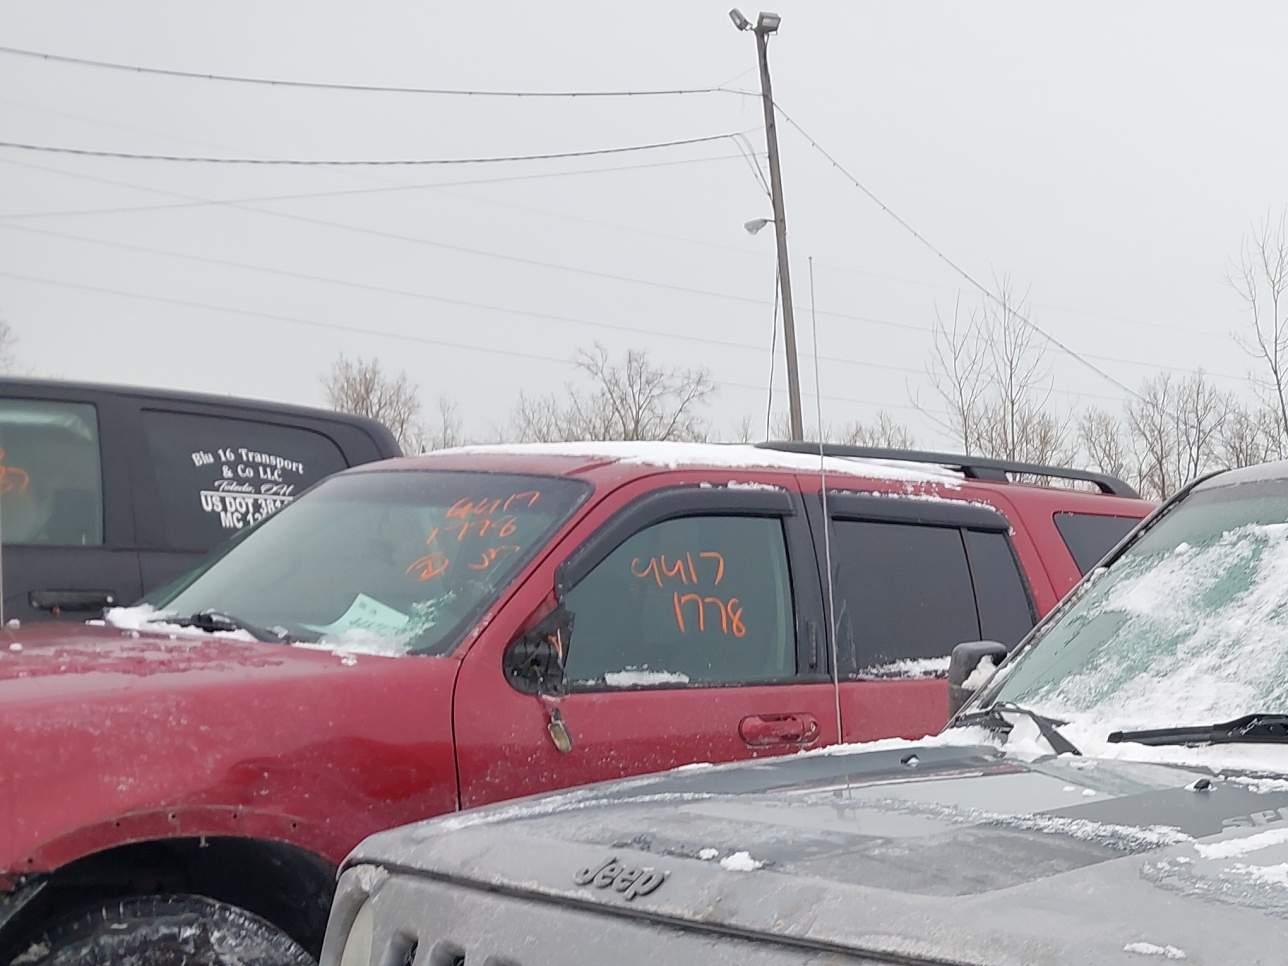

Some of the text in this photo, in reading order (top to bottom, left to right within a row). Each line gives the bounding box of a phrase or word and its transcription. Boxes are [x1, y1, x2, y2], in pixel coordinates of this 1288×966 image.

[217, 448, 235, 462] 16
[239, 448, 304, 475] Transport
[222, 464, 283, 482] & Co LLC
[201, 495, 222, 512] US
[225, 497, 255, 514] DOT
[220, 511, 244, 529] MC
[673, 591, 746, 638] 1778
[574, 857, 671, 902] Jeep
